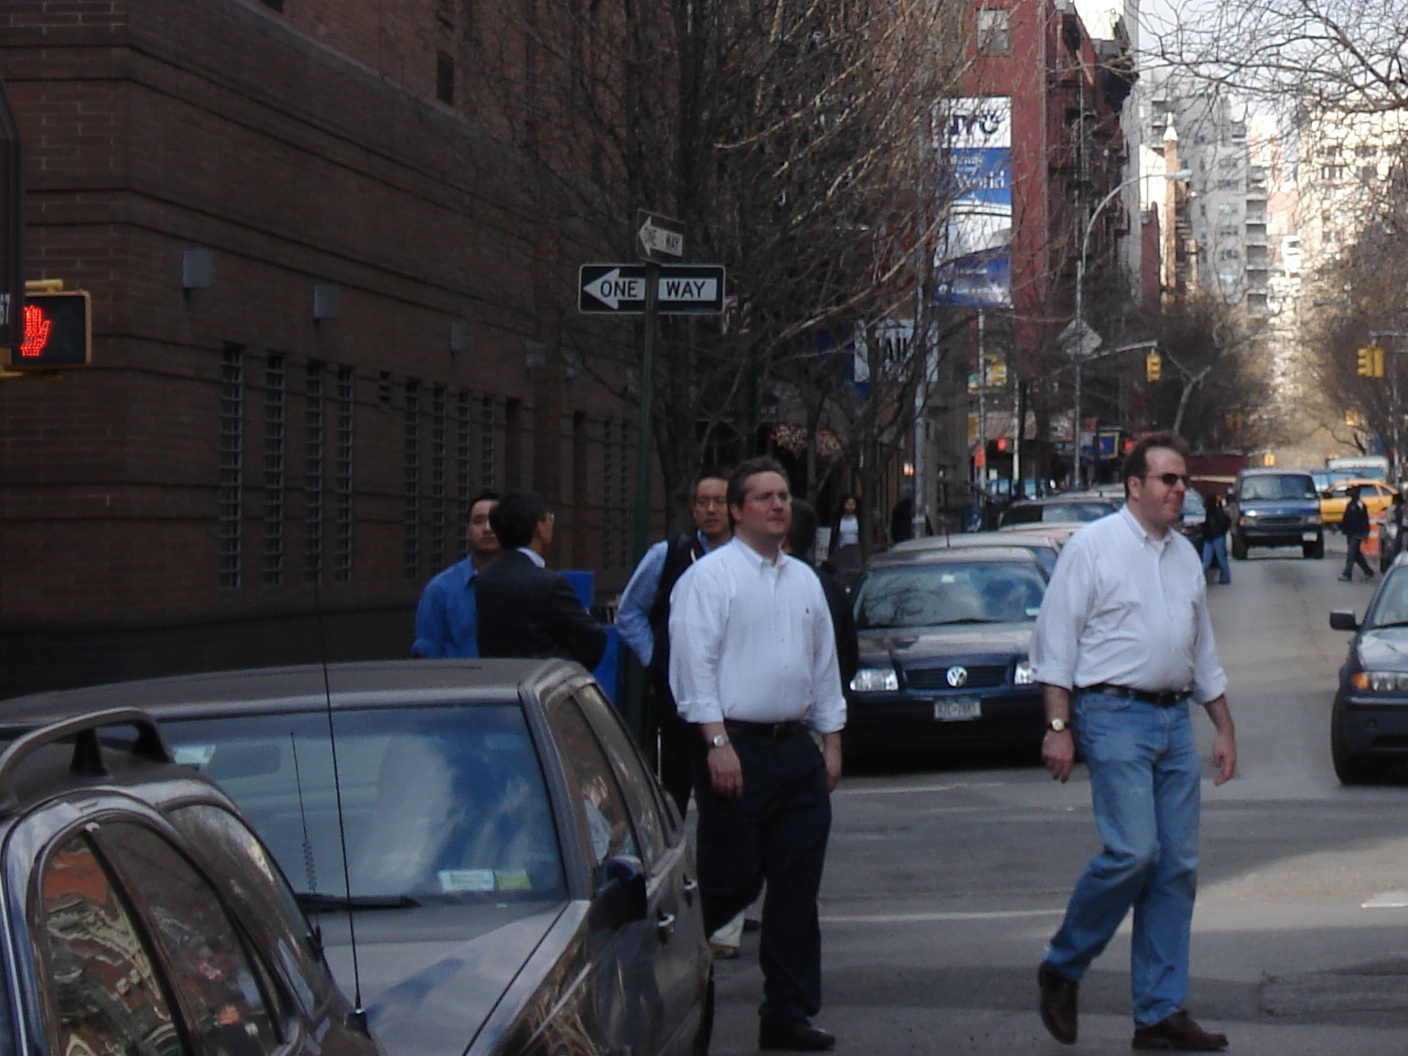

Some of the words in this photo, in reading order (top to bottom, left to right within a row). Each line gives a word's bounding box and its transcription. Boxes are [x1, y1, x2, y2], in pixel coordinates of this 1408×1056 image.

[643, 226, 657, 248] ONE
[665, 234, 681, 252] WAY
[600, 280, 638, 298] ONE
[665, 280, 706, 299] WAY
